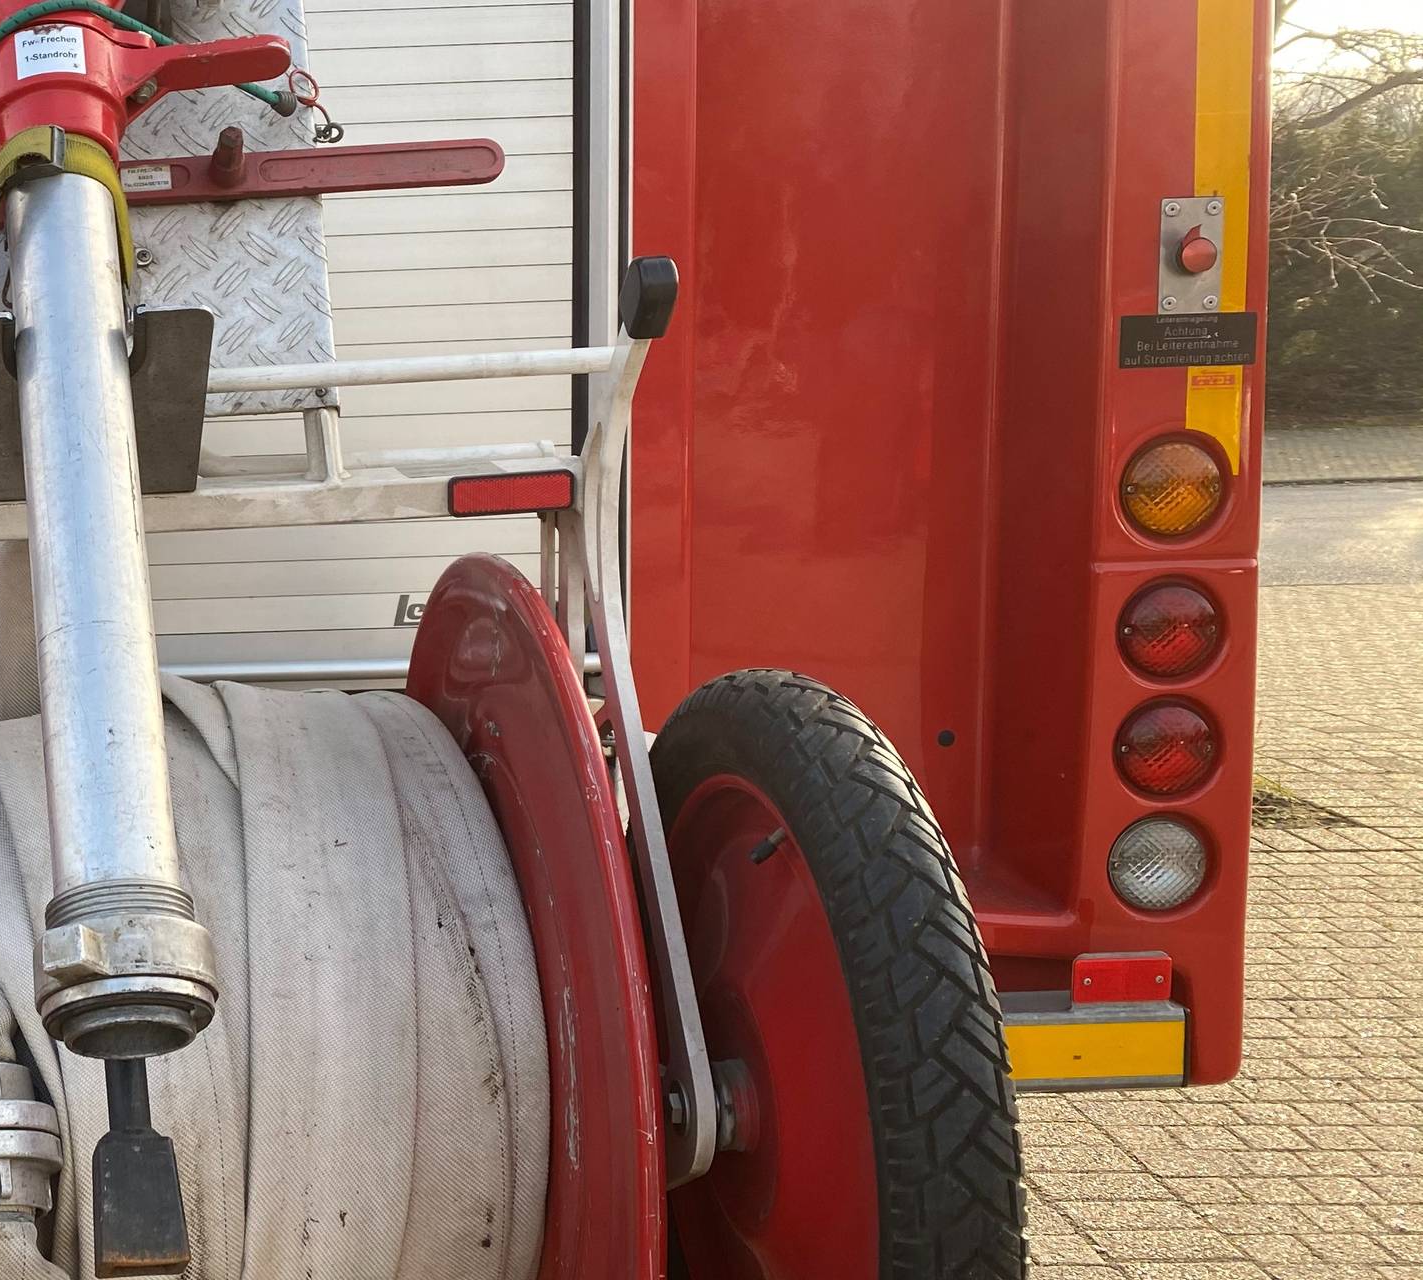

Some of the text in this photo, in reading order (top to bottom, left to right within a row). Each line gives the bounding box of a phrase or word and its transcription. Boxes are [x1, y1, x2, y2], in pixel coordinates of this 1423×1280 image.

[40, 35, 77, 44] Frechen
[25, 51, 77, 62] 1-Standrohr
[1137, 339, 1239, 351] Bei Leiterentnahme
[1124, 352, 1250, 365] auf Stromleitung achten
